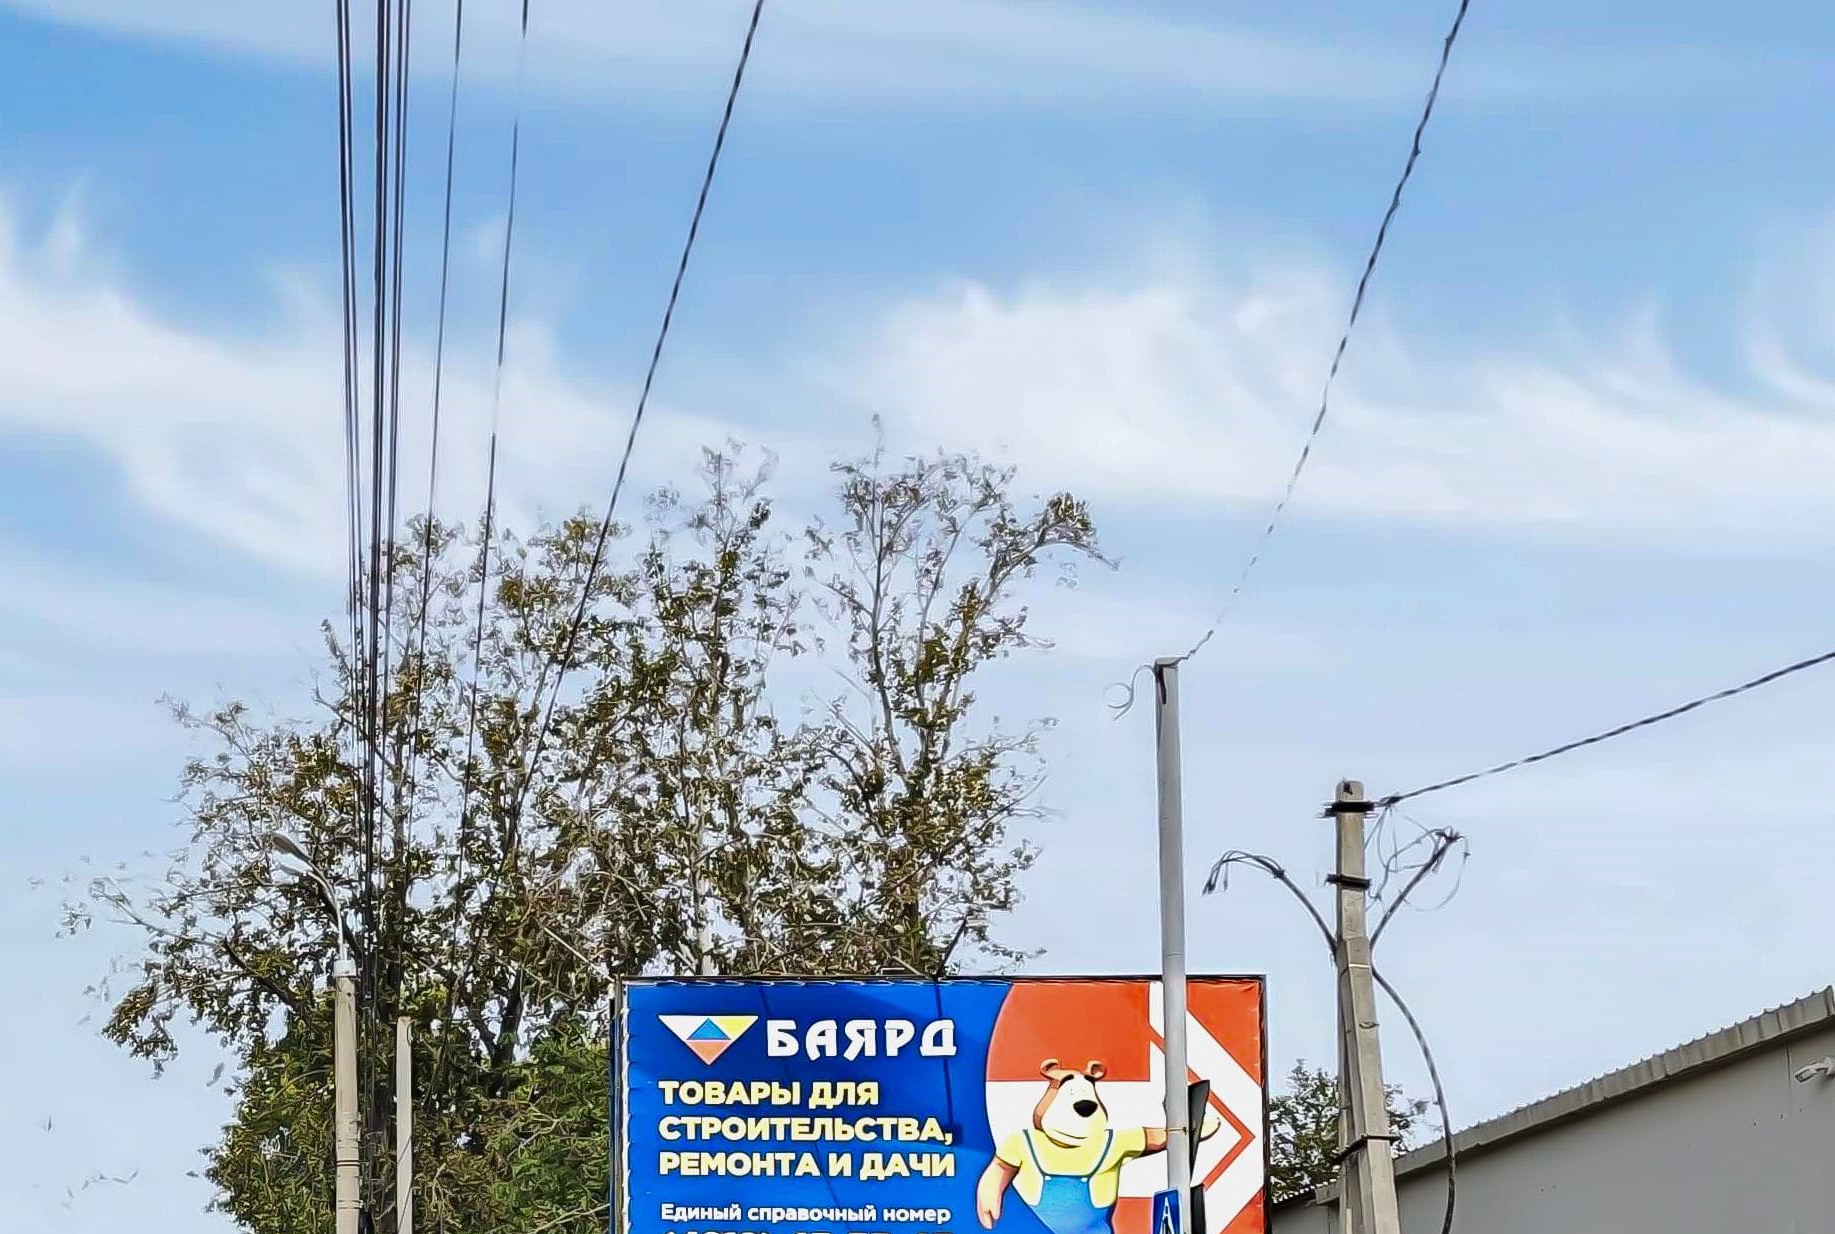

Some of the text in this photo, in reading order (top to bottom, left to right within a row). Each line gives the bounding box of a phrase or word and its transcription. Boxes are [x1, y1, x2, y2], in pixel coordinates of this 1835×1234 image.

[766, 1019, 957, 1061] БАЯРД
[658, 1081, 879, 1109] ТОВАРЫ ДЛЯ
[658, 1116, 953, 1145] СТРОИТЕЛЬСТВА,
[659, 1152, 955, 1181] РЕМОНТА И ДАЧИ
[661, 1203, 951, 1224] Единый справочный номер
